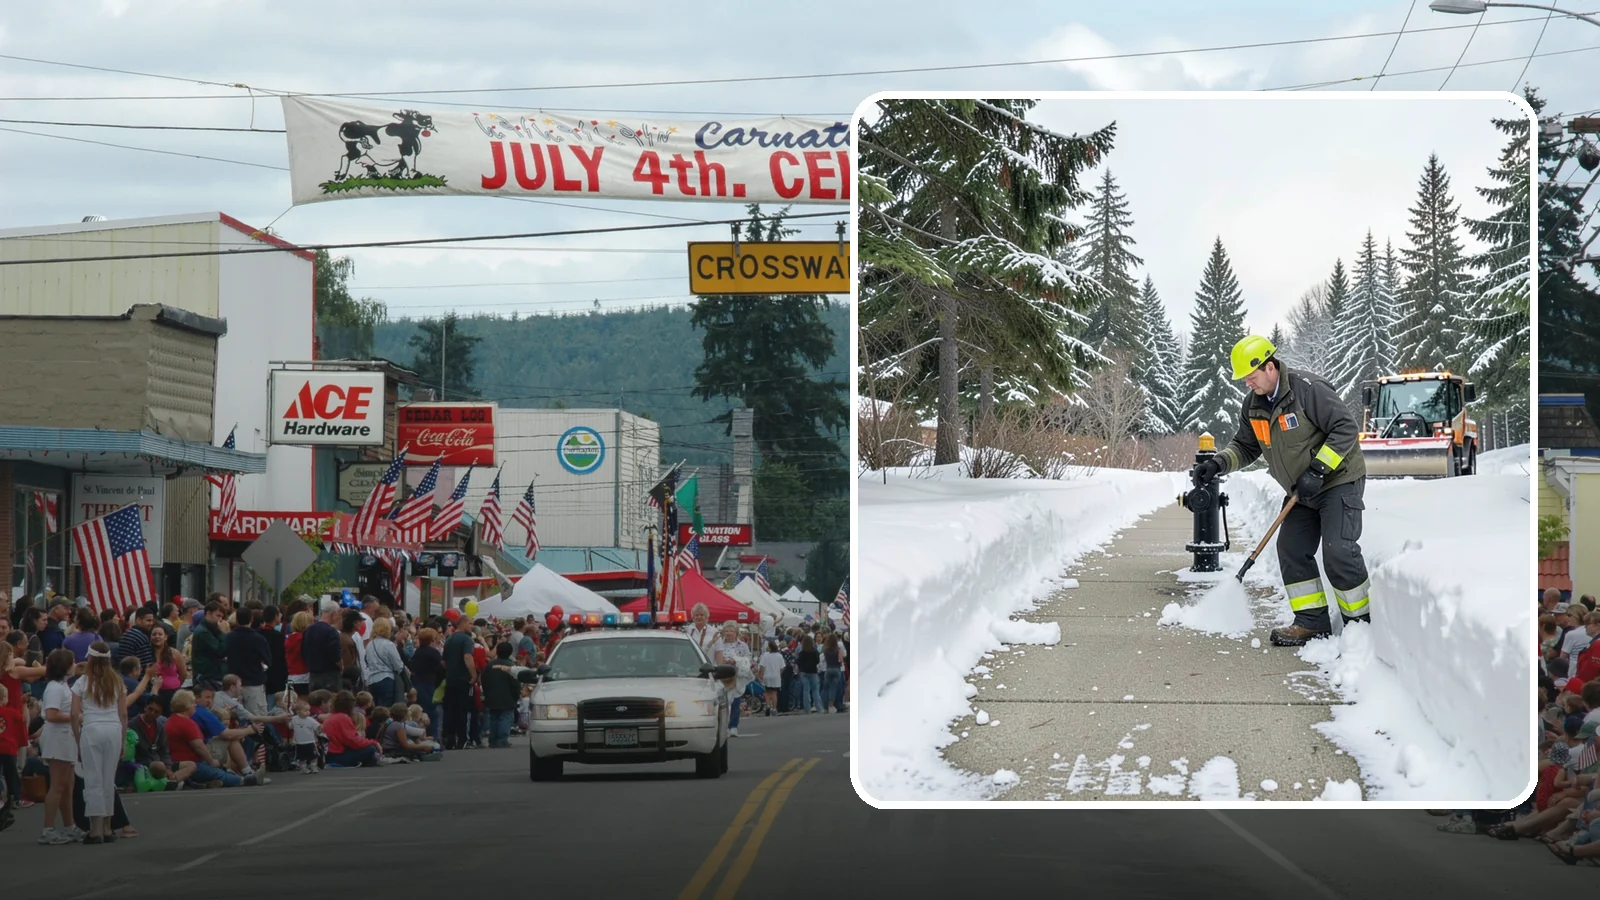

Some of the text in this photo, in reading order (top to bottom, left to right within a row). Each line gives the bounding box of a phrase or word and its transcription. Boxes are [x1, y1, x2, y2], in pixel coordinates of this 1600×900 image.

[694, 121, 850, 150] Carnat
[481, 141, 604, 192] JULY
[632, 149, 746, 198] 4th.
[697, 254, 850, 280] CROSSWA
[283, 380, 373, 419] ACE
[405, 409, 485, 422] CEDAR LOG
[283, 421, 371, 436] Hardware
[416, 428, 476, 447] Coca-Cola
[95, 485, 124, 495] Vincent
[126, 486, 136, 495] de
[138, 486, 155, 496] Paul
[688, 526, 741, 535] CRNATION
[699, 535, 730, 543] GLASS
